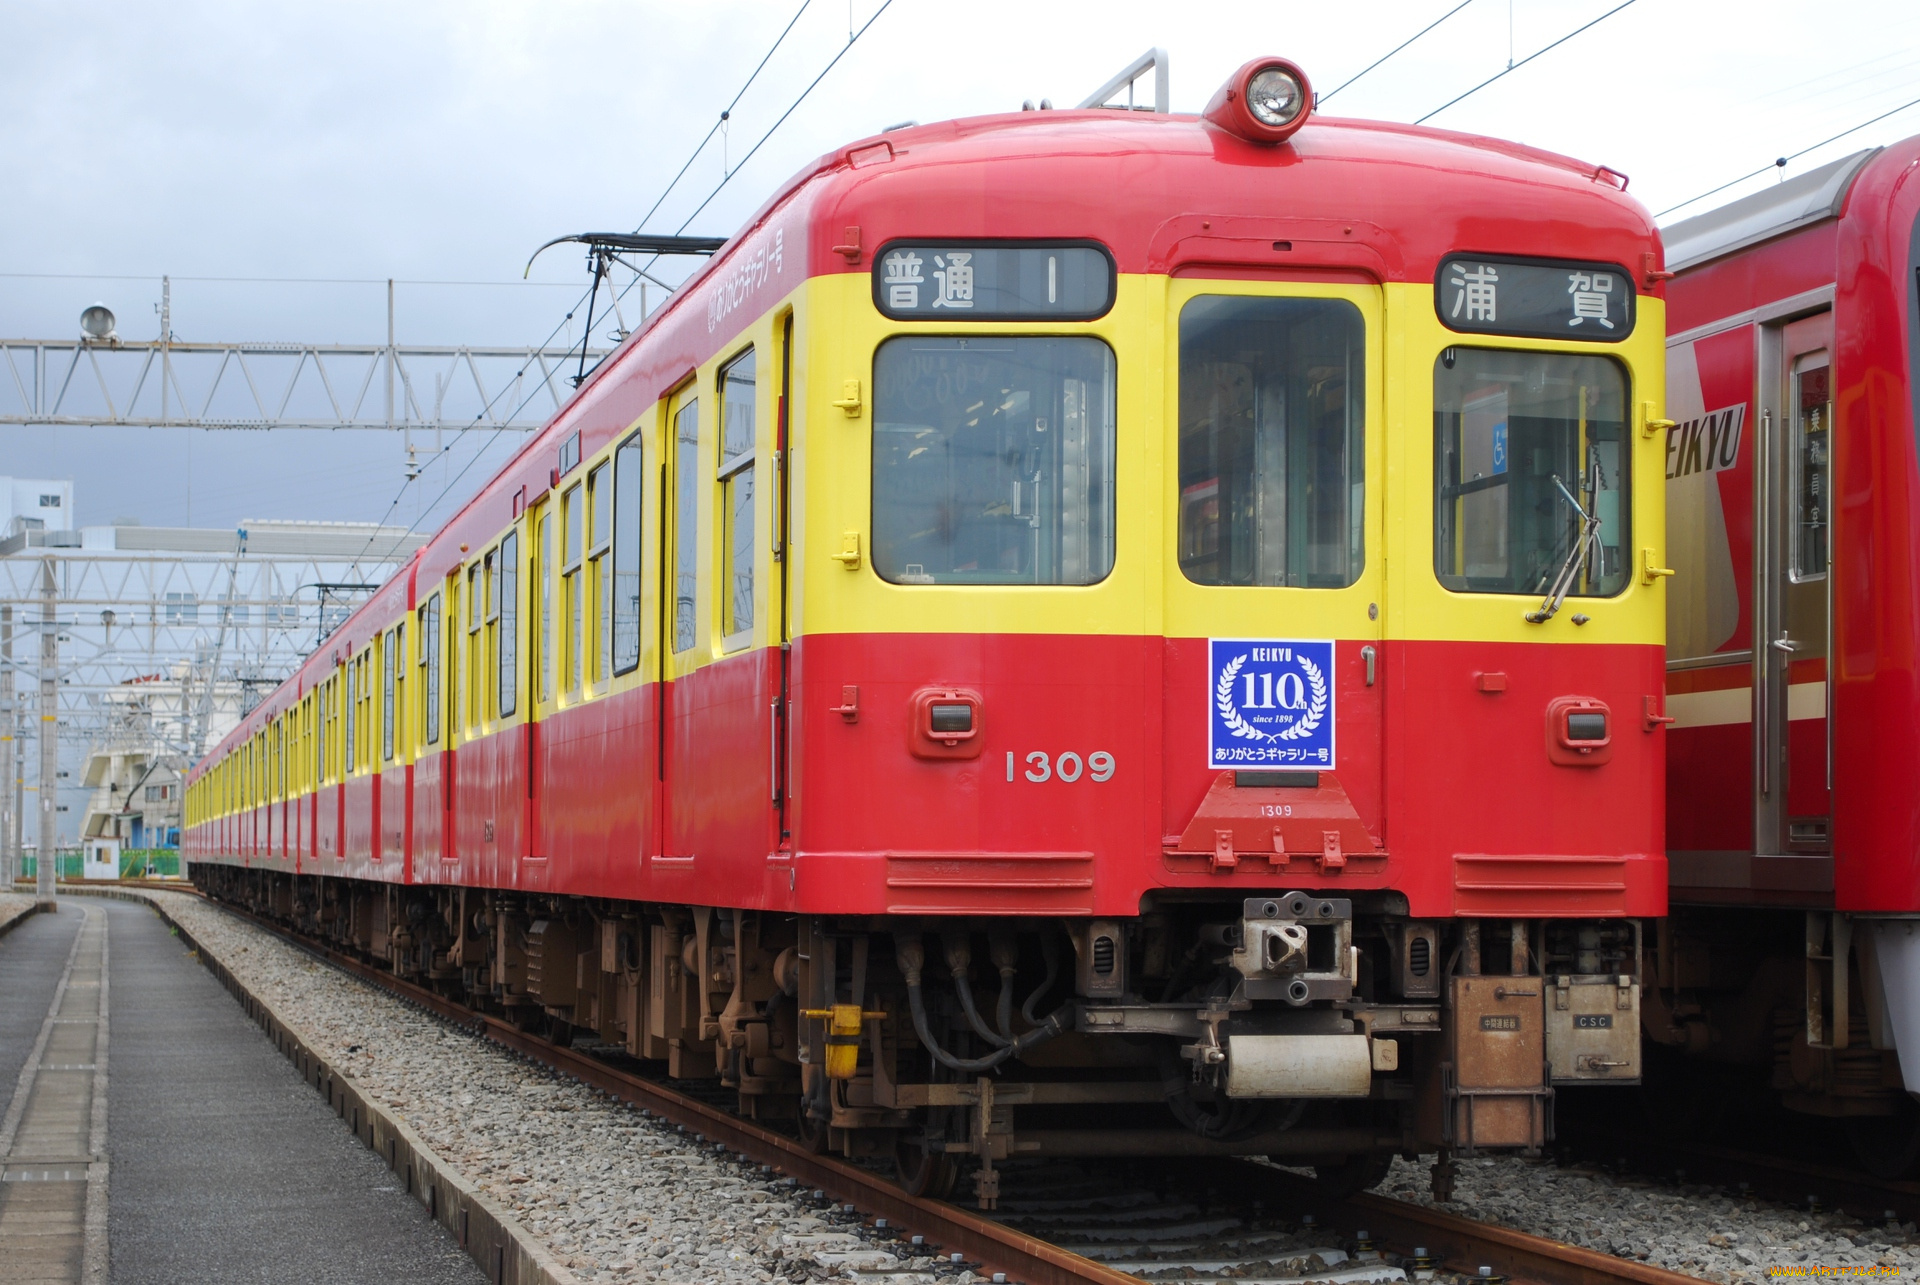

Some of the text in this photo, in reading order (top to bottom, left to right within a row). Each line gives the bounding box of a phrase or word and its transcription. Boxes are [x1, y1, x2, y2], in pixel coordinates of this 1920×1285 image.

[716, 228, 783, 322] ありがとうギャラリー号
[885, 252, 973, 308] 普通
[1450, 264, 1614, 330] 浦賀
[1810, 408, 1820, 529] 乗務員室
[1252, 648, 1292, 662] KEIKYU
[1252, 714, 1294, 723] since 1898
[1006, 751, 1116, 783] 1309
[1215, 747, 1329, 762] ありがとうギャラリー号
[1261, 805, 1292, 817] 1309
